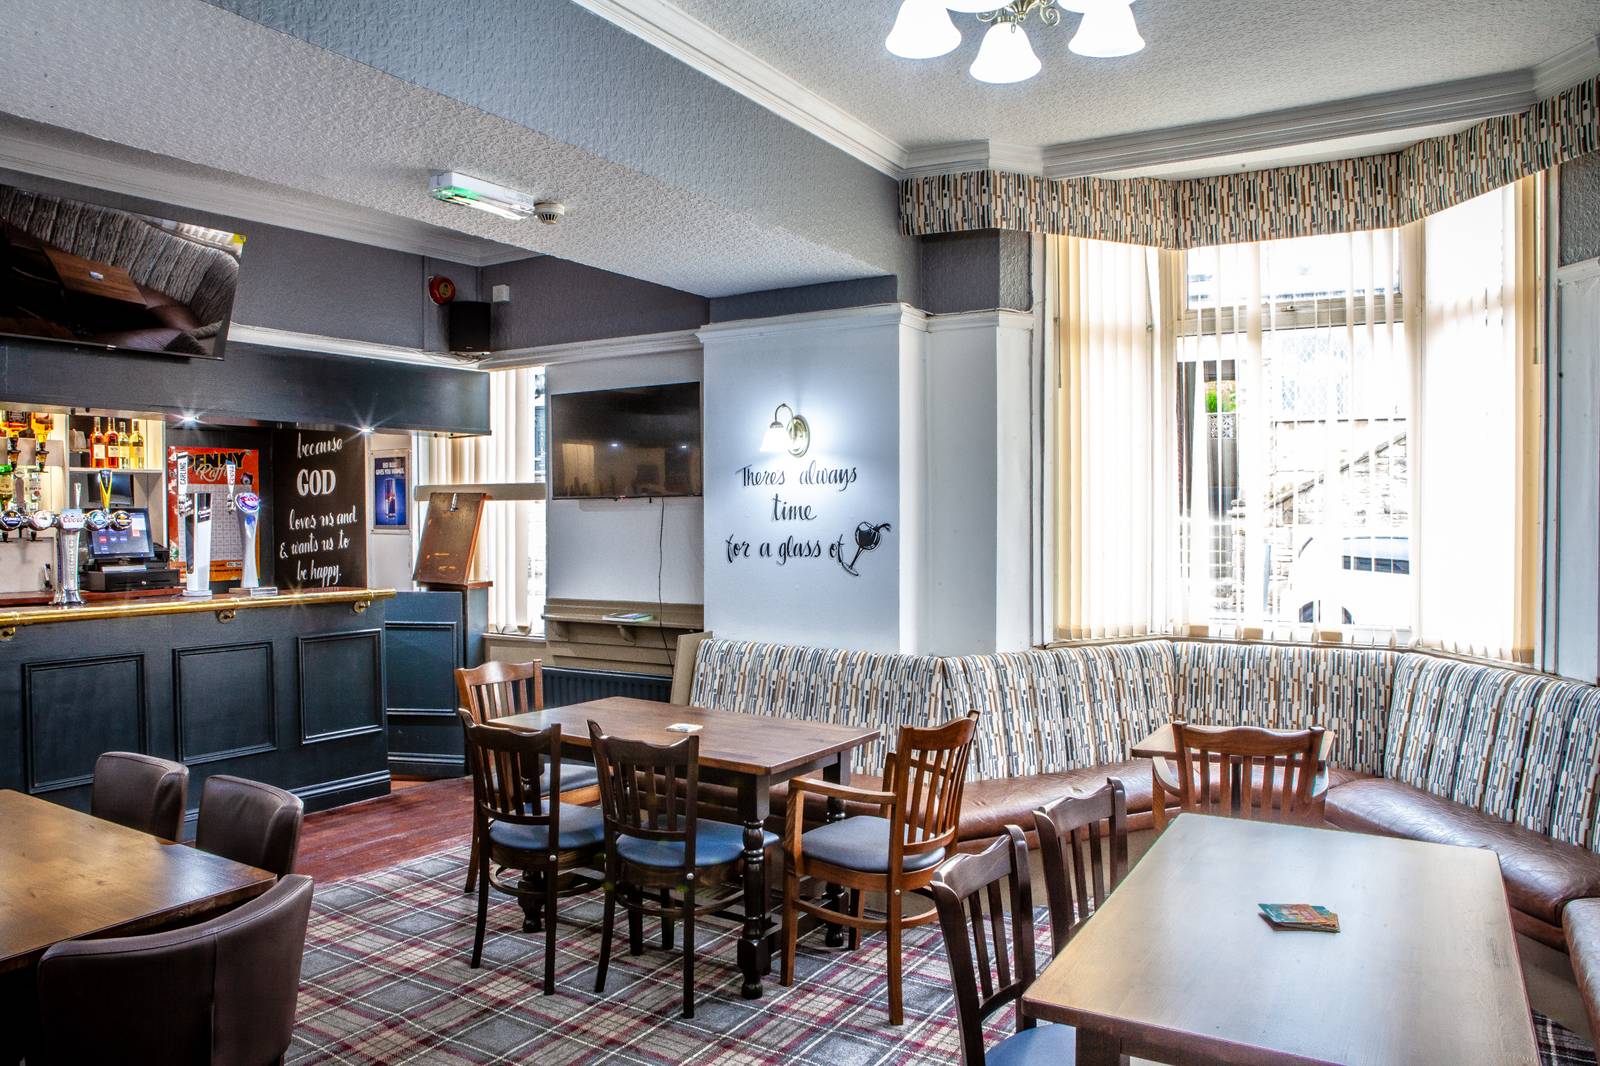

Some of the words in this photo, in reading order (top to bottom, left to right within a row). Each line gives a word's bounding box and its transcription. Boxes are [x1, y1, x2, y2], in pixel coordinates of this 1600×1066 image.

[297, 432, 343, 459] because
[297, 469, 337, 496] GOD
[799, 459, 857, 492] always
[289, 508, 317, 530] loves
[320, 512, 335, 527] us
[336, 504, 358, 525] and
[772, 493, 817, 521] time
[279, 542, 289, 559] &
[291, 532, 319, 555] wants
[322, 537, 335, 551] us
[337, 528, 351, 549] to
[725, 534, 751, 564] for
[760, 541, 773, 558] a
[776, 535, 822, 566] glass
[829, 534, 845, 563] of
[297, 560, 308, 581] be
[310, 559, 342, 588] happy.
